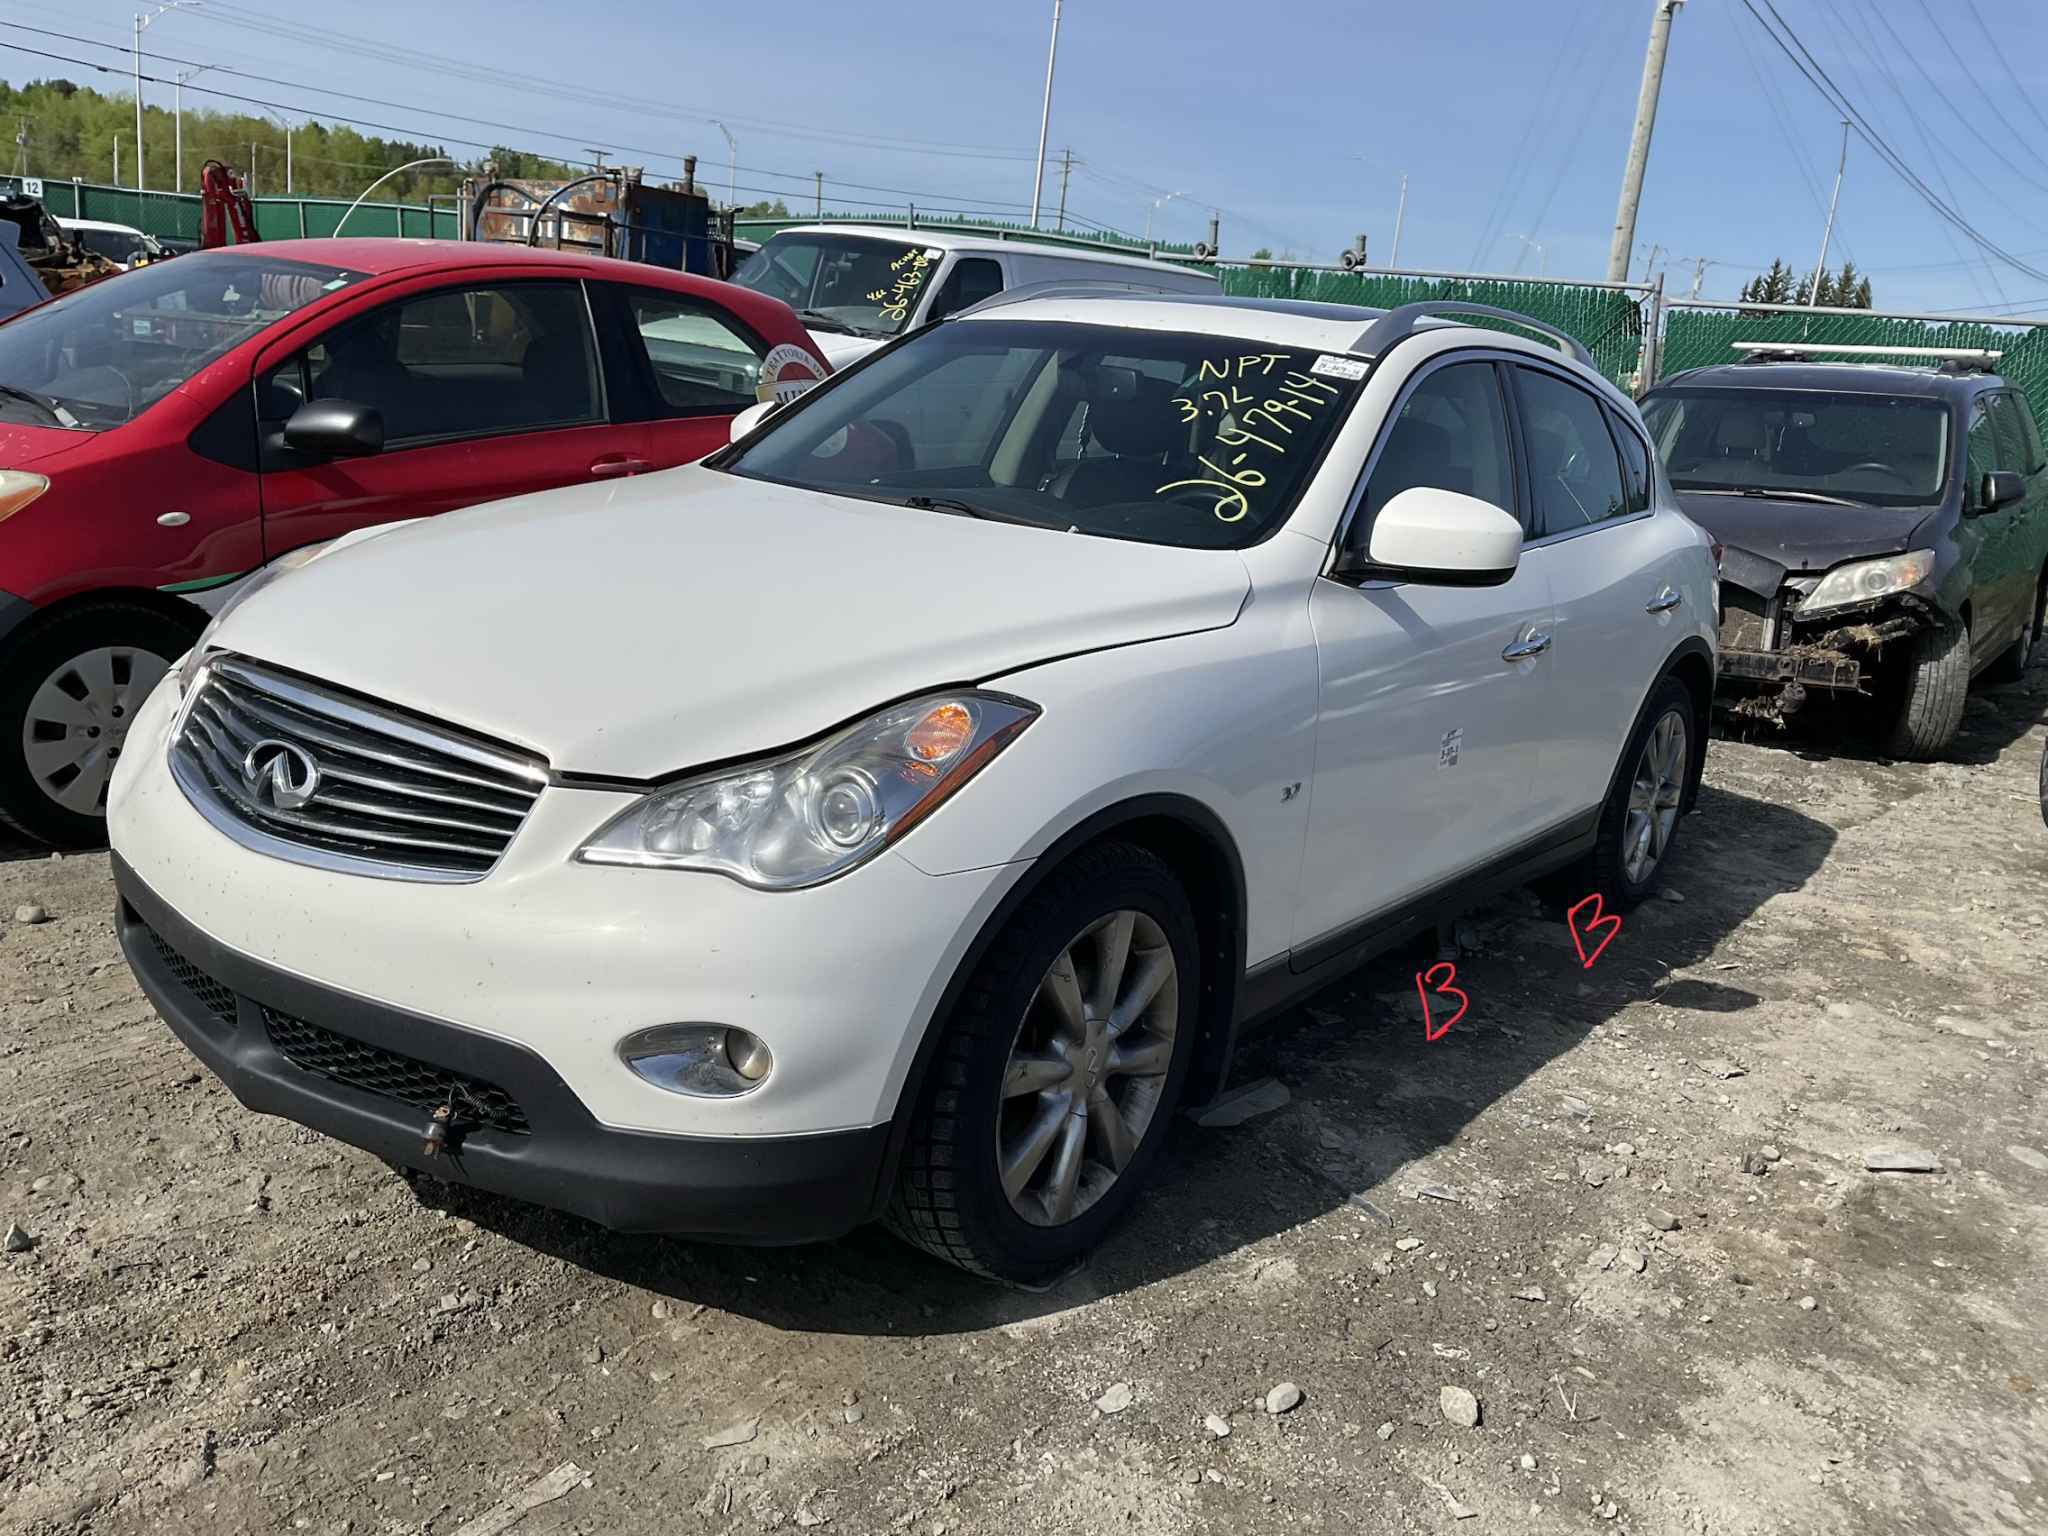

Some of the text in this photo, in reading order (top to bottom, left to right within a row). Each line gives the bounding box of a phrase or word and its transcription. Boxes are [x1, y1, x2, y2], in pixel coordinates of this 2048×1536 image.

[26, 181, 39, 194] 12
[1199, 353, 1291, 381] NPT
[1170, 386, 1254, 423] 3.7L
